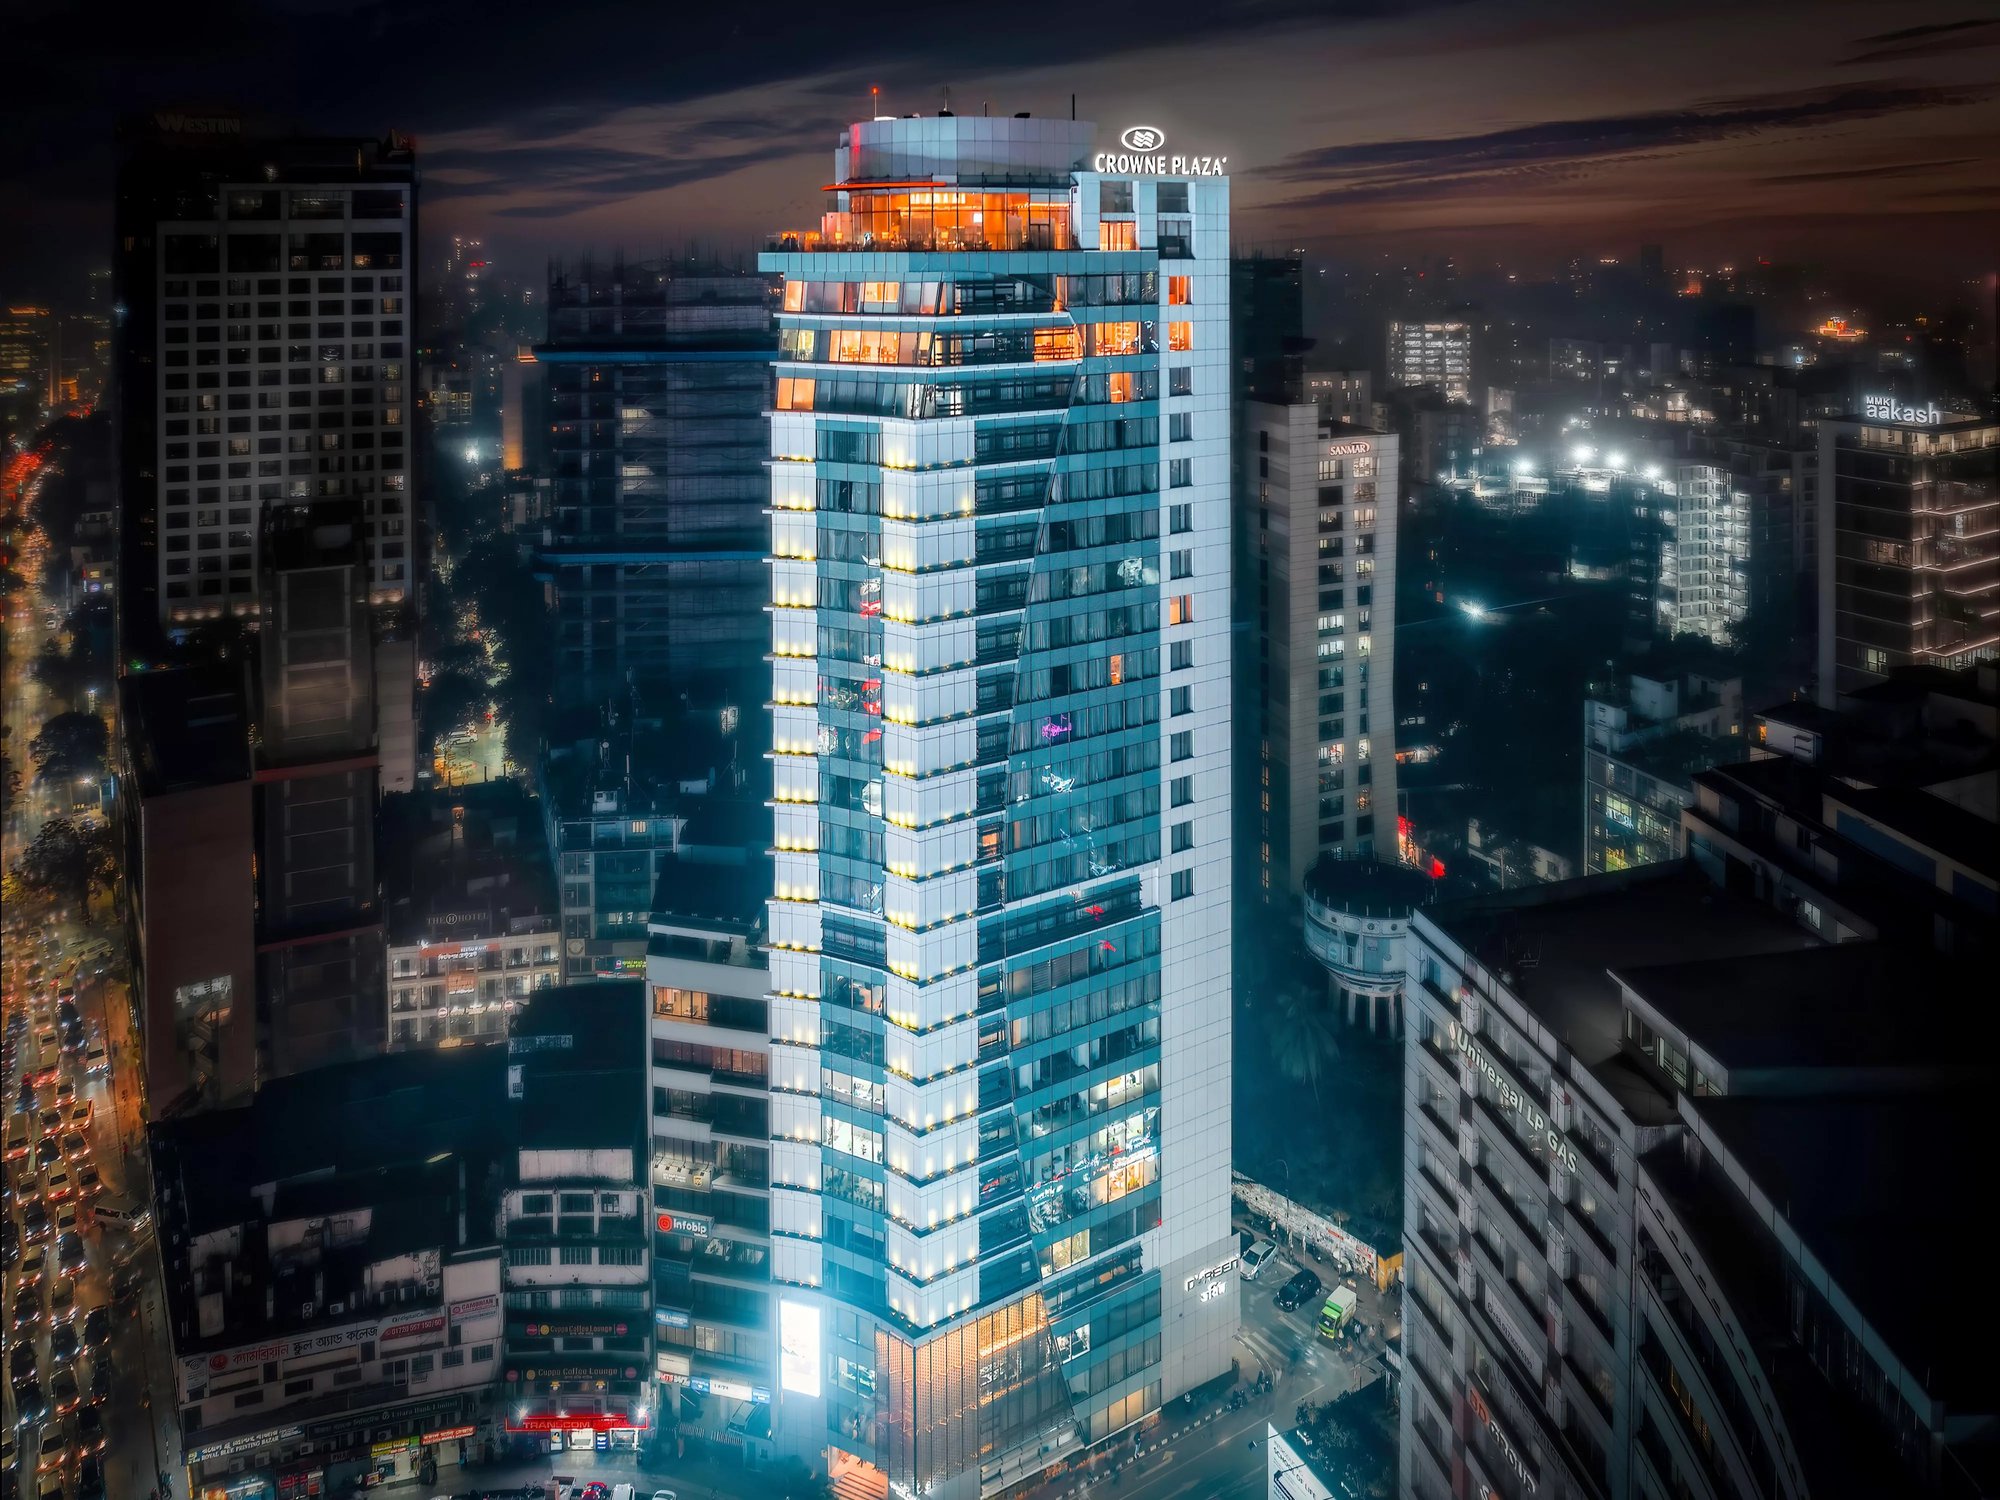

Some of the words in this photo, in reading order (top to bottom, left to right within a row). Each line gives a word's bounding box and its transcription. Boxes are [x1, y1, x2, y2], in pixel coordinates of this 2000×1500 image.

[1094, 153, 1166, 175] CROWNE
[1172, 156, 1224, 177] PLAZA
[1866, 395, 1891, 406] MMK
[1866, 399, 1941, 425] aakash
[1330, 443, 1368, 456] SANMAR
[458, 912, 489, 923] HOTEL
[1457, 1026, 1525, 1114] Universal
[1526, 1104, 1545, 1132] LP
[1547, 1129, 1578, 1174] GAS
[346, 1325, 379, 1342] কলেজ
[523, 1421, 591, 1429] TRANSCOM
